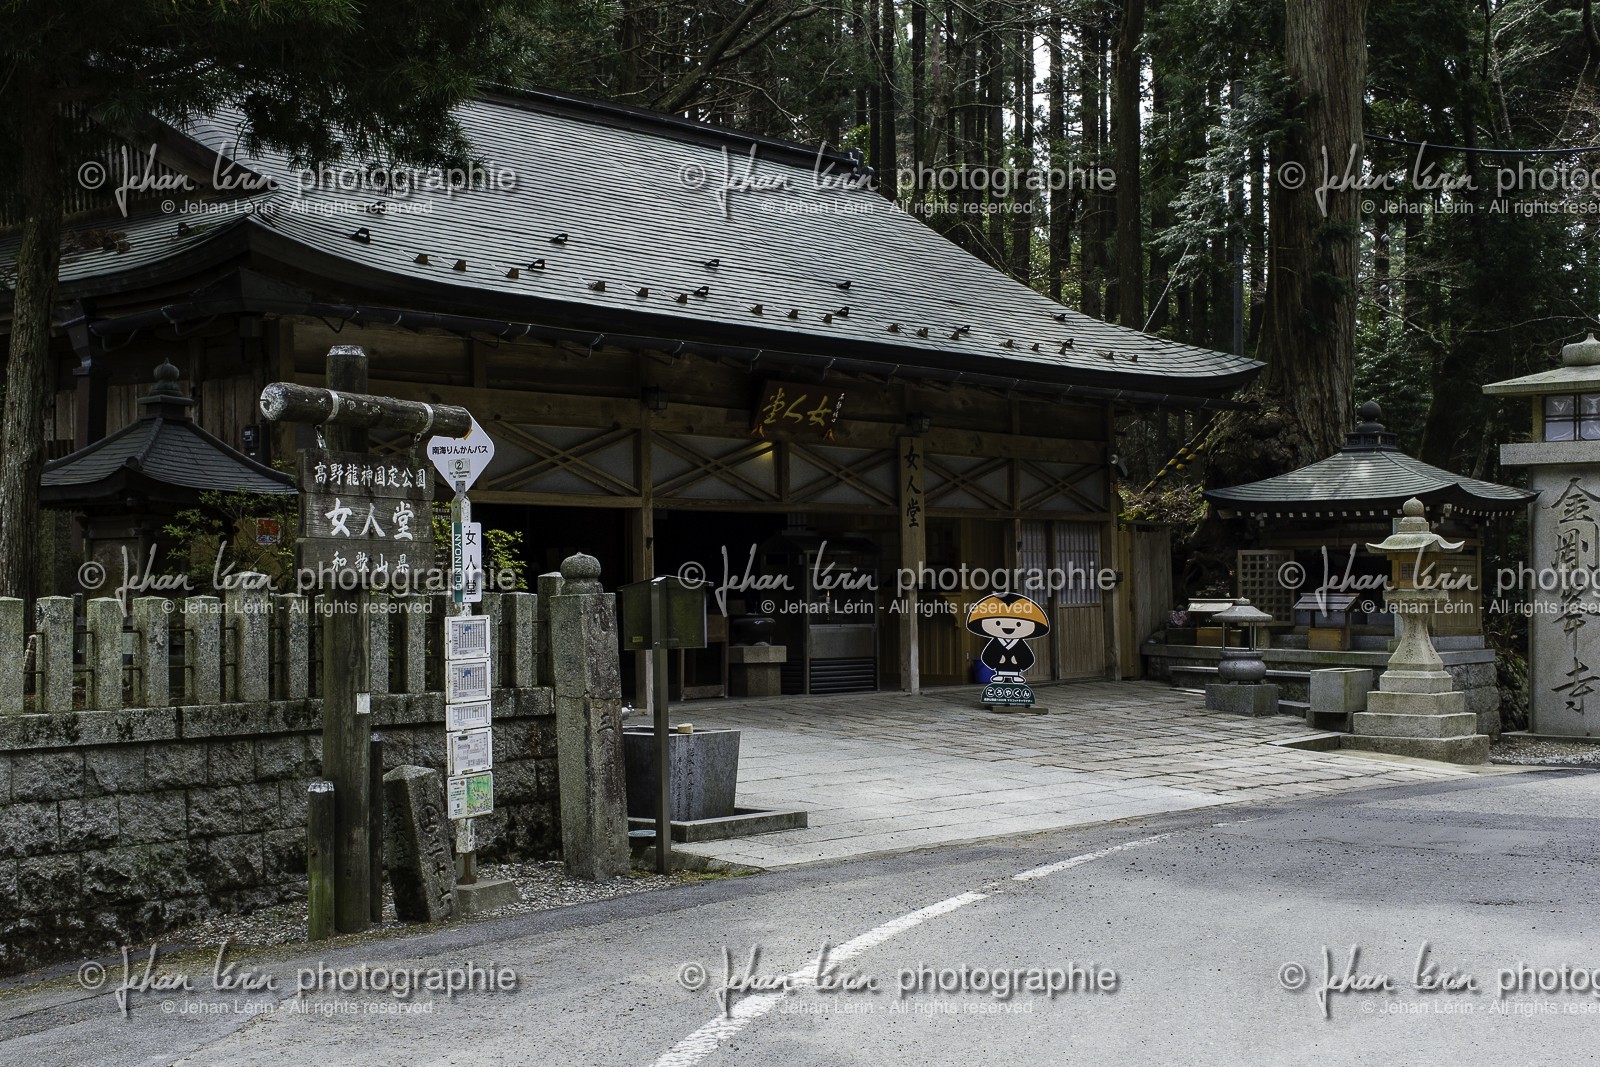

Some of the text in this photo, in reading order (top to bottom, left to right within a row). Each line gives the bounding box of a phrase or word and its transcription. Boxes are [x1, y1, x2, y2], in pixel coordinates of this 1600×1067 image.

[432, 445, 488, 455] 南海りんかんバス
[903, 439, 922, 528] 女人堂
[325, 497, 414, 541] 女人堂
[331, 551, 410, 573] 和歌山県
[454, 533, 462, 590] NYONINDO
[465, 529, 477, 595] 女人堂
[986, 688, 1031, 698] こうやくん
